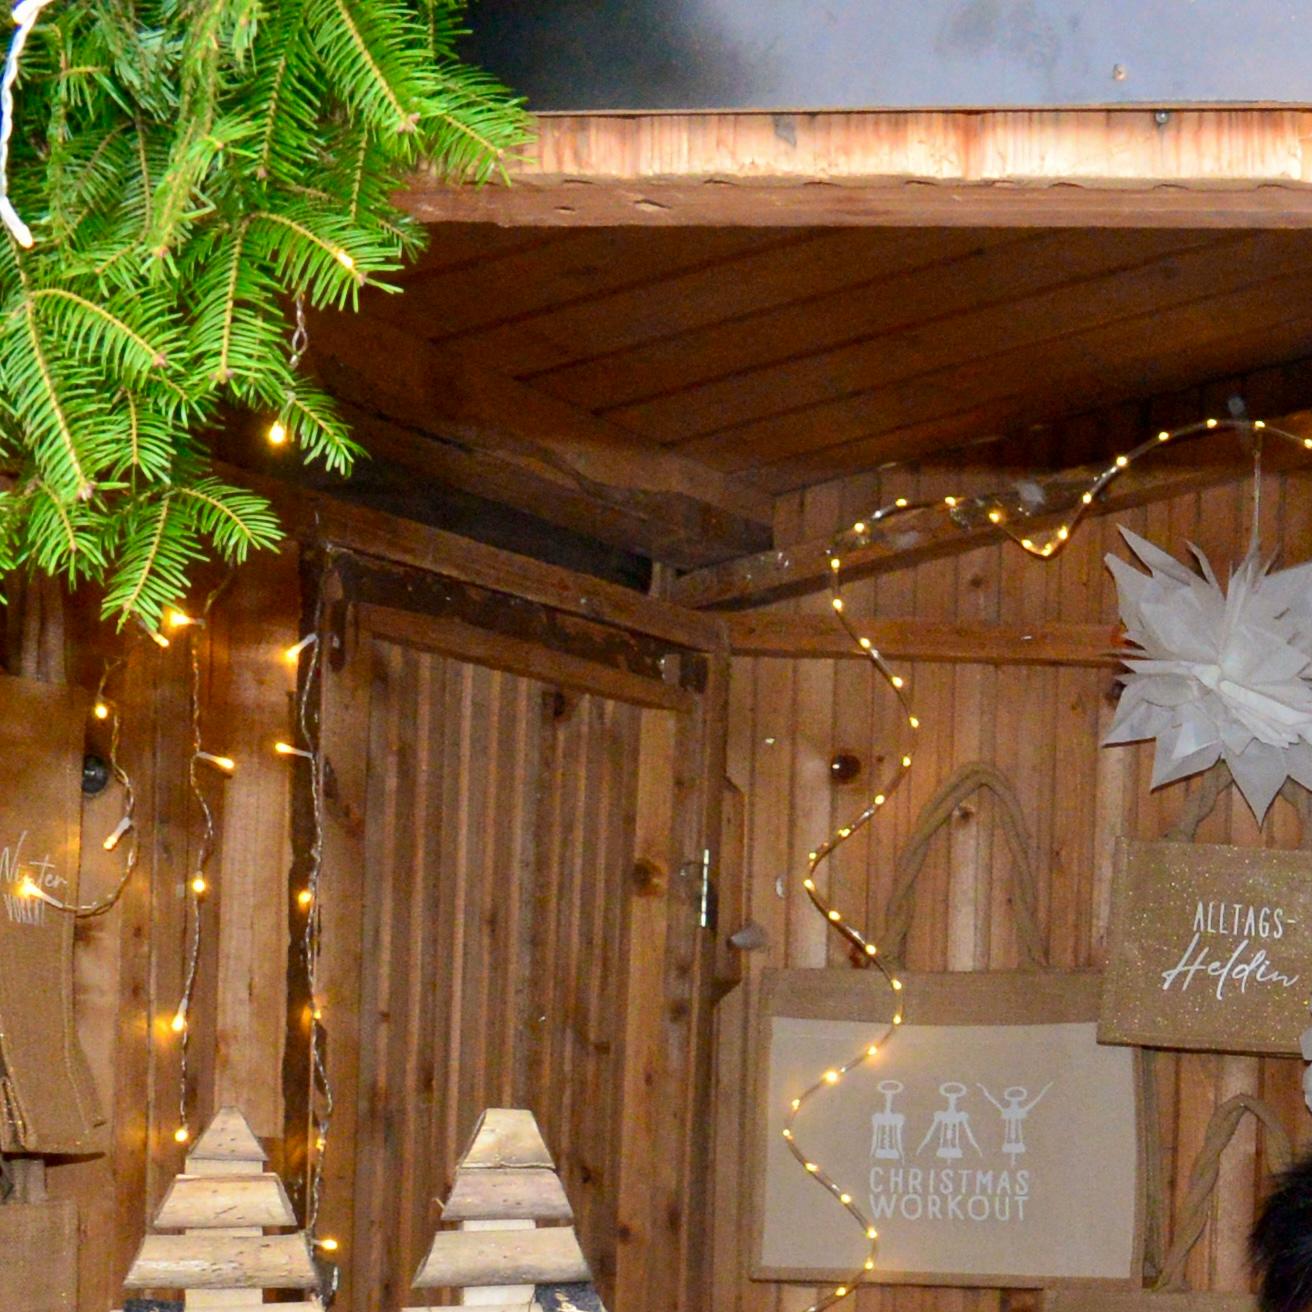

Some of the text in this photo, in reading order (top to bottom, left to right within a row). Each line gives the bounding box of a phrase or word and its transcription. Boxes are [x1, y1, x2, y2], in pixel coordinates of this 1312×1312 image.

[1193, 900, 1297, 938] ALLTAGS-
[1161, 932, 1299, 1000] Heldin
[869, 1166, 1030, 1195] CHRISTMAS
[869, 1194, 1029, 1221] WORKOUT
